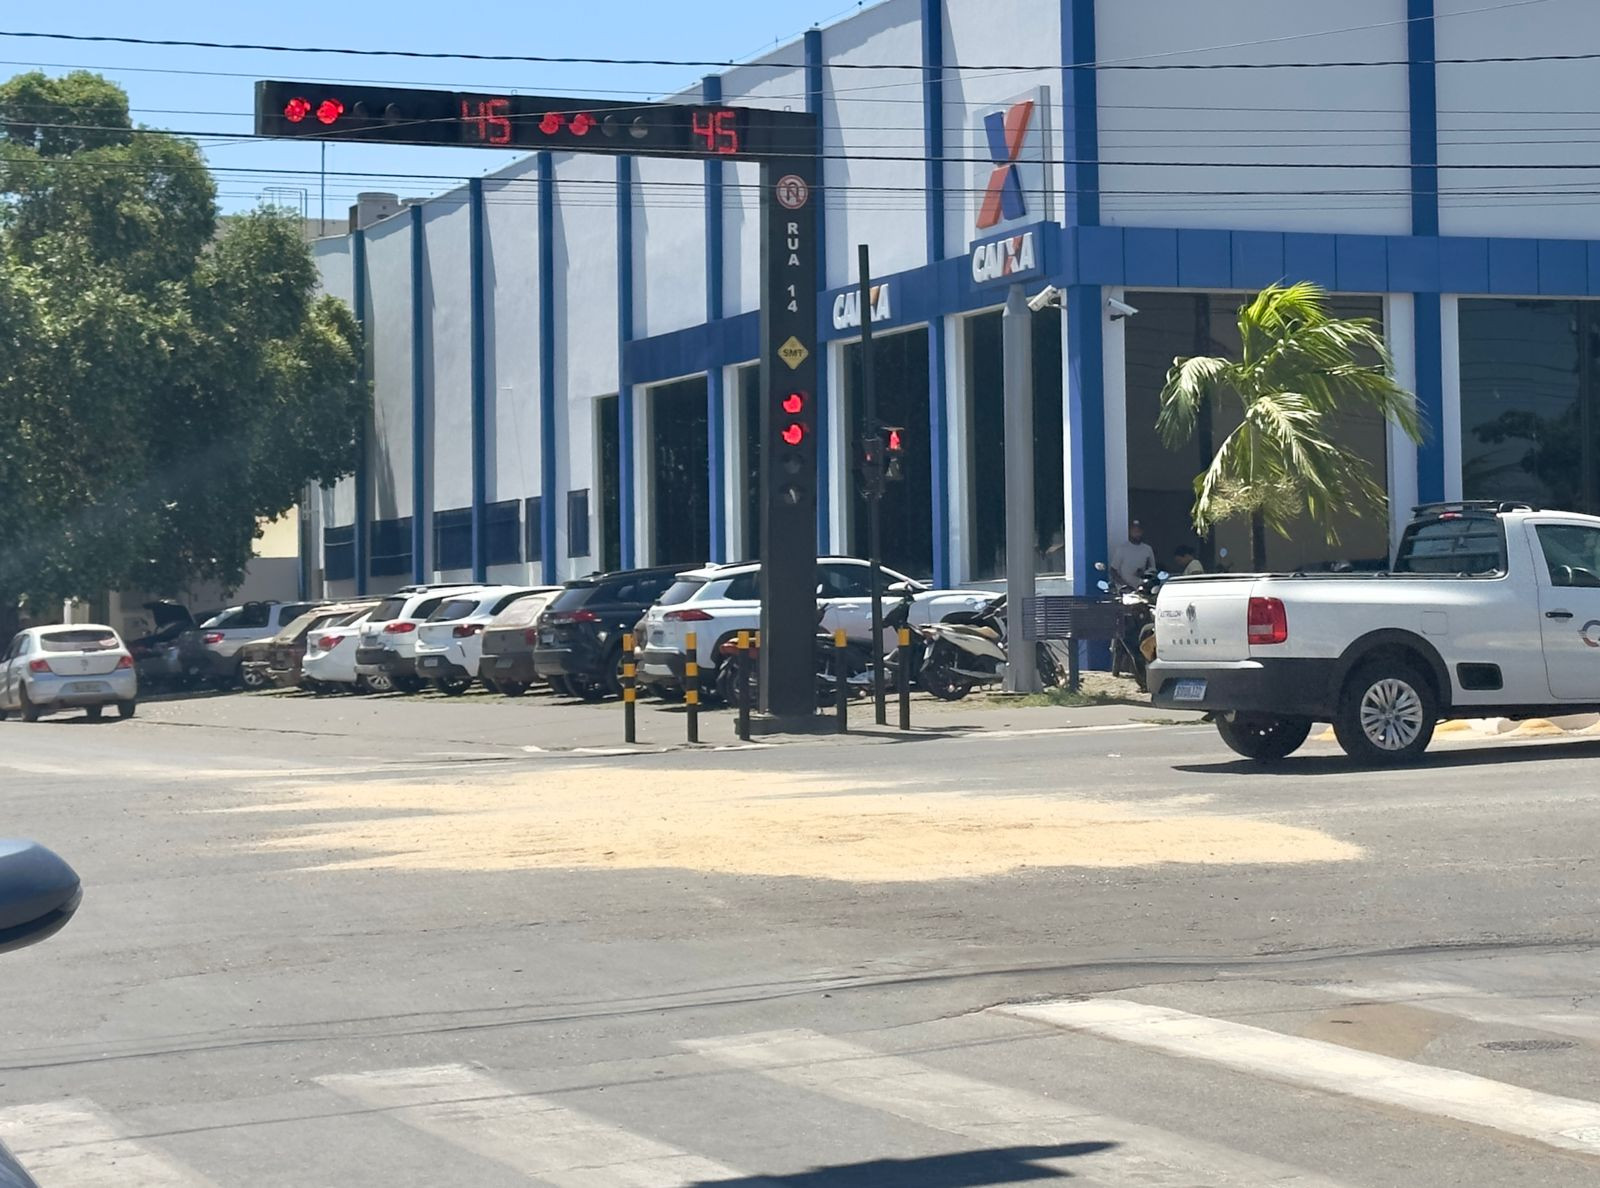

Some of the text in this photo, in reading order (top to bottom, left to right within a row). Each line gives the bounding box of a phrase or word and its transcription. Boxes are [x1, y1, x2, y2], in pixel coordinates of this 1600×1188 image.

[461, 98, 511, 144] 45
[692, 111, 737, 154] 45
[786, 222, 800, 313] RUA 14
[972, 232, 1036, 283] CAIXA
[782, 347, 804, 359] SMT
